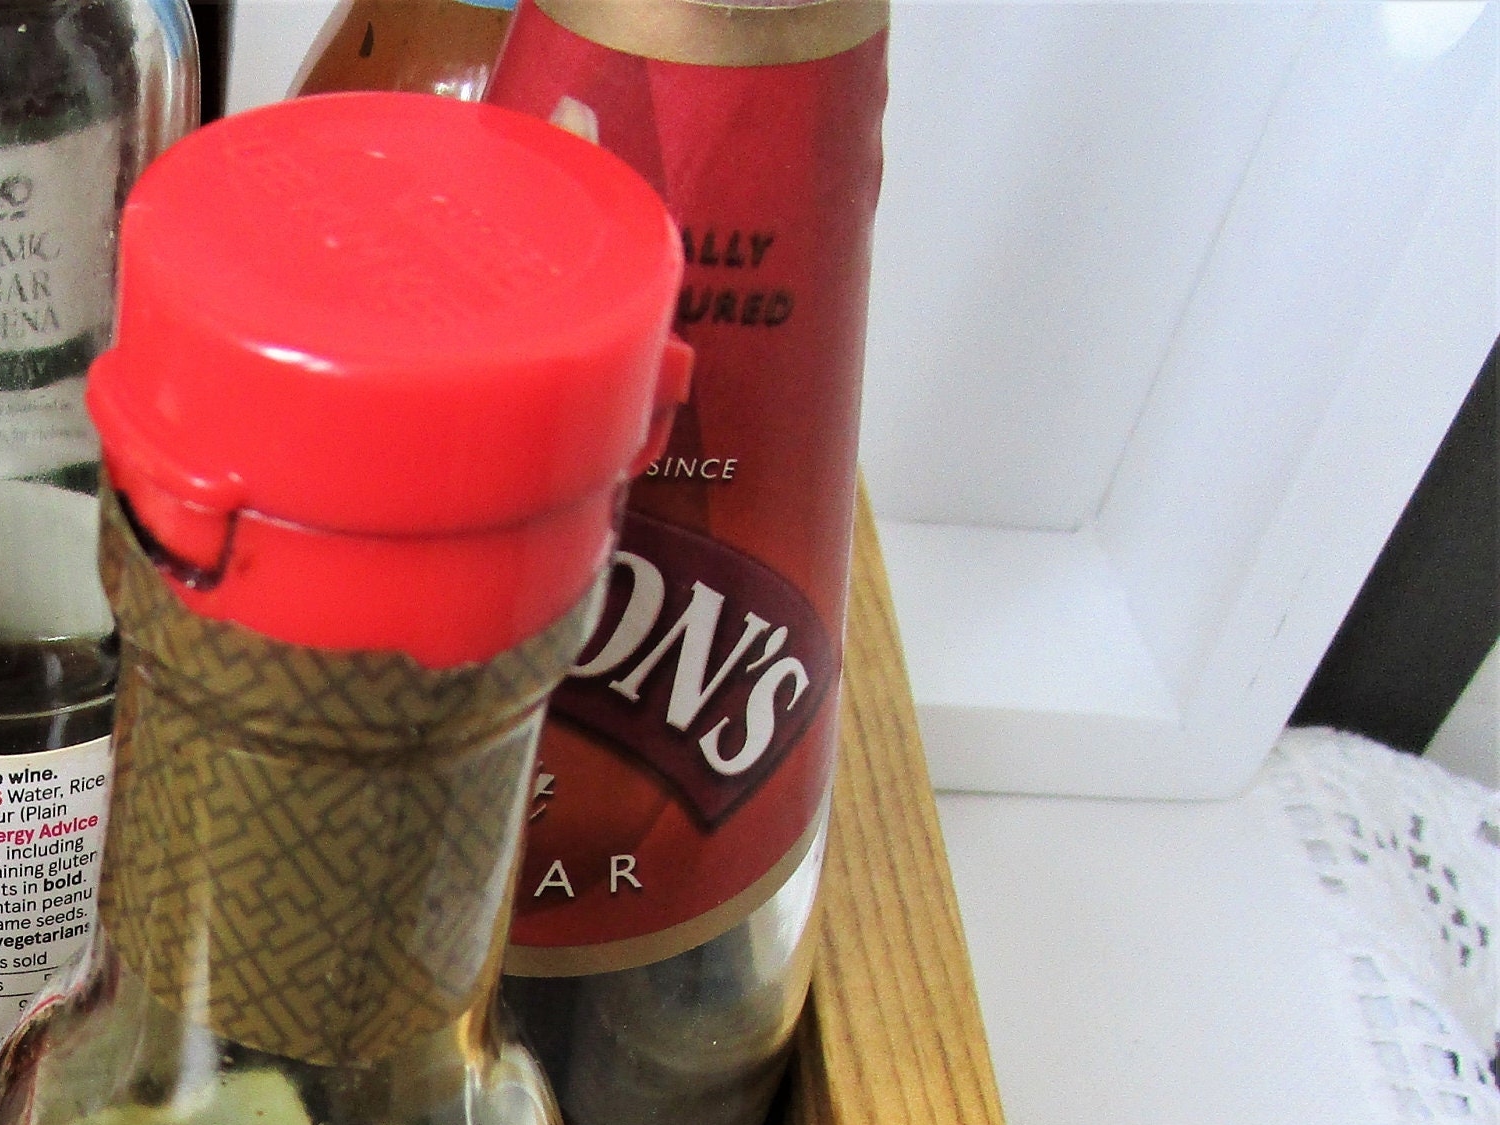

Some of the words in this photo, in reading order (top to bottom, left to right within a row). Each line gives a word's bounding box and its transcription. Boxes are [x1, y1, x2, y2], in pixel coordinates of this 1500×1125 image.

[646, 458, 738, 480] SINCE
[9, 768, 58, 785] wine.
[7, 787, 63, 804] Water,
[70, 773, 105, 795] Rice
[21, 803, 67, 823] (Plain
[39, 815, 98, 838] Advice
[6, 836, 84, 860] including
[23, 881, 37, 894] in
[43, 871, 86, 892] bold.
[36, 908, 88, 928] seeds.
[13, 951, 47, 967] sold
